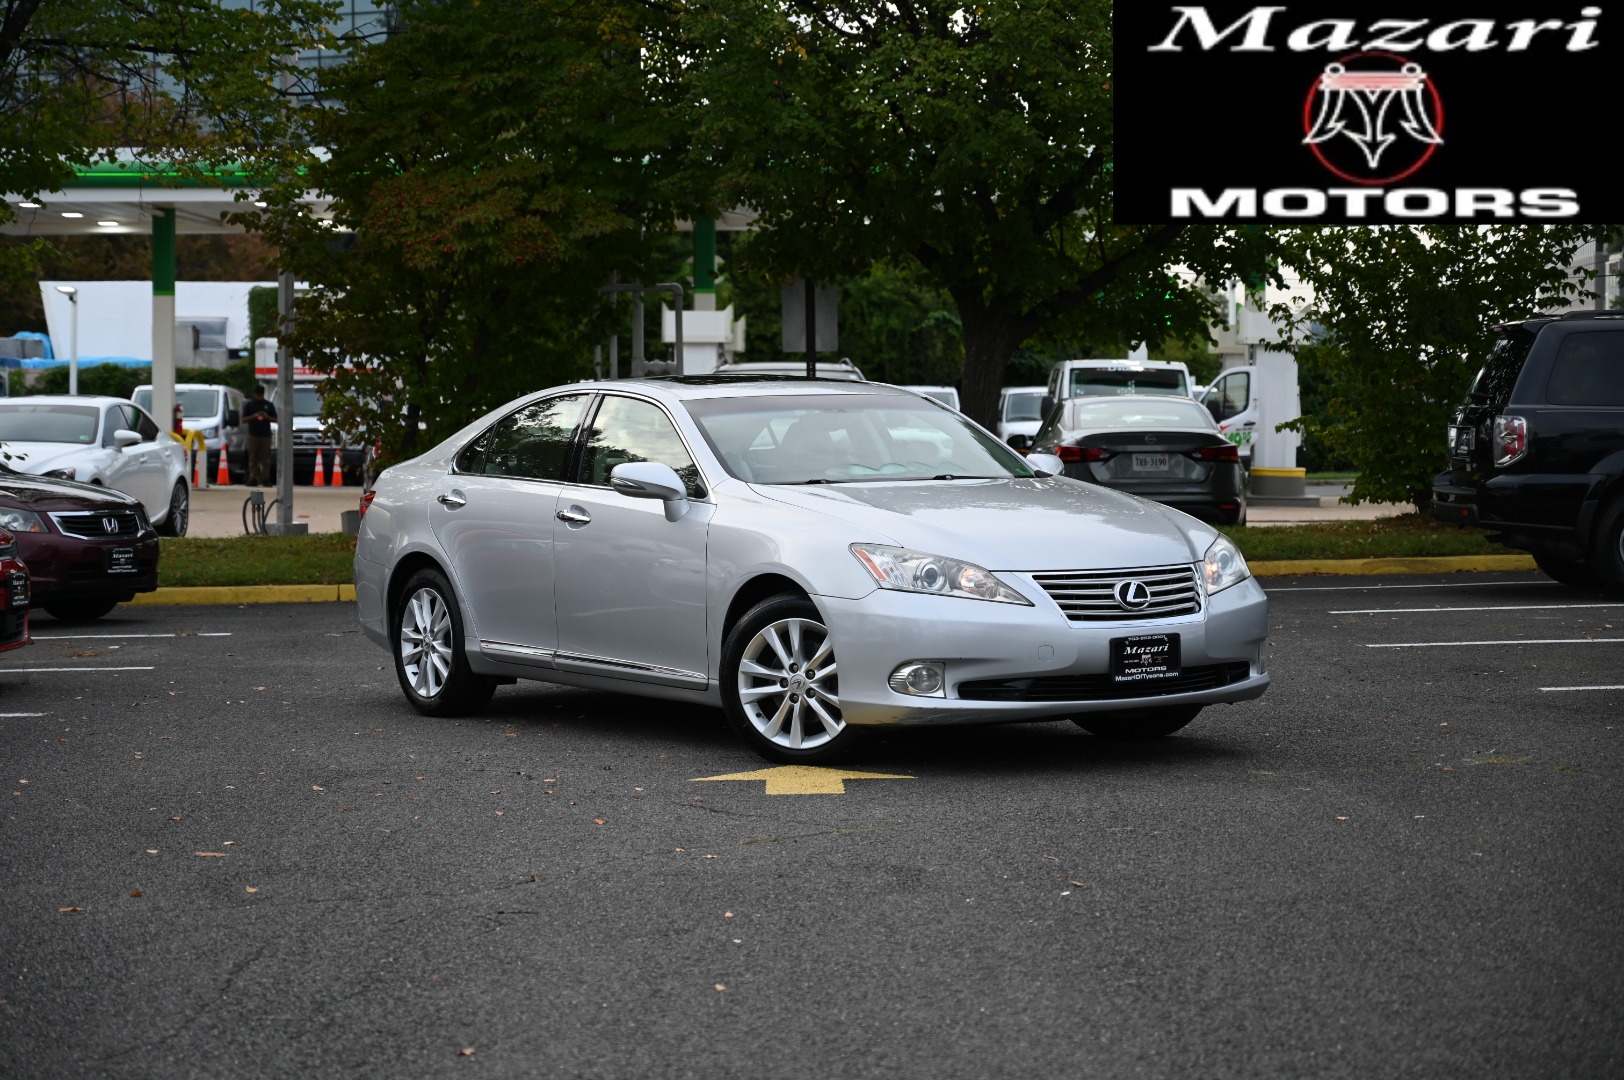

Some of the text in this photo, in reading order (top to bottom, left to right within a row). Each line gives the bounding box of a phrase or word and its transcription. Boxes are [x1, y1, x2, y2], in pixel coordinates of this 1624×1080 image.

[1136, 457, 1167, 467] TRB-3190
[1123, 643, 1169, 655] Mazari
[1125, 665, 1167, 674] MOTORS
